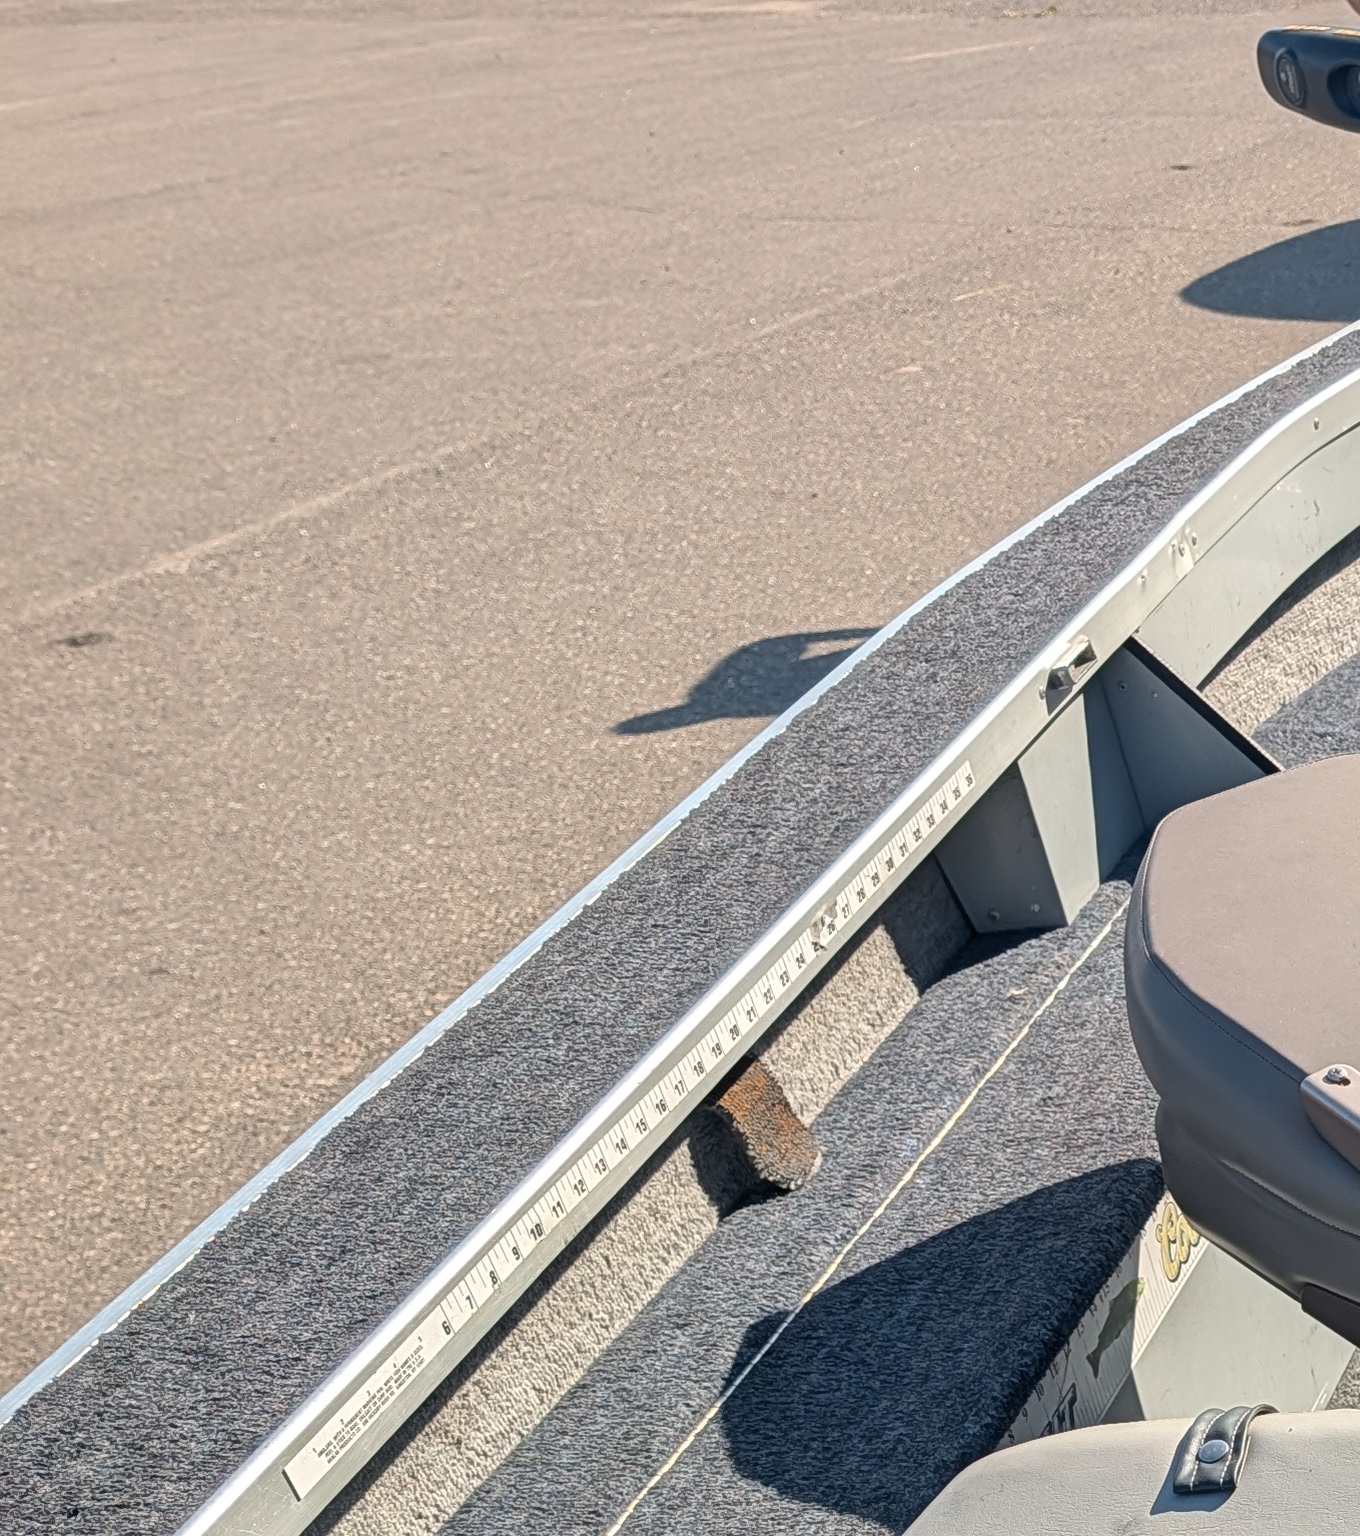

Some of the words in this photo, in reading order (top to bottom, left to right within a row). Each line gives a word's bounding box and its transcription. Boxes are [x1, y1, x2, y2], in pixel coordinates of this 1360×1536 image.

[442, 1321, 451, 1335] 6
[466, 1295, 474, 1310] 7
[489, 1270, 498, 1285] 8
[512, 1246, 520, 1260] 9
[530, 1223, 543, 1240] 10
[552, 1201, 564, 1218] 11
[574, 1180, 586, 1196] 12
[595, 1158, 606, 1175] 13
[616, 1138, 628, 1155] 14
[636, 1118, 647, 1135] 15
[656, 1099, 667, 1115] 16
[675, 1080, 685, 1096] 17
[694, 1061, 704, 1078] 18
[712, 1042, 722, 1058] 19
[730, 1024, 740, 1041] 20
[747, 1006, 756, 1022] 21
[764, 988, 773, 1005] 22
[780, 971, 790, 987] 23
[796, 953, 805, 969] 24
[842, 904, 850, 919] 27
[857, 888, 866, 903] 28
[871, 872, 879, 887] 29
[886, 857, 894, 872] 30
[899, 843, 908, 857] 31
[913, 828, 922, 842] 32
[927, 814, 935, 828] 33
[940, 800, 948, 814] 34
[953, 787, 961, 801] 35
[965, 773, 973, 787] 36
